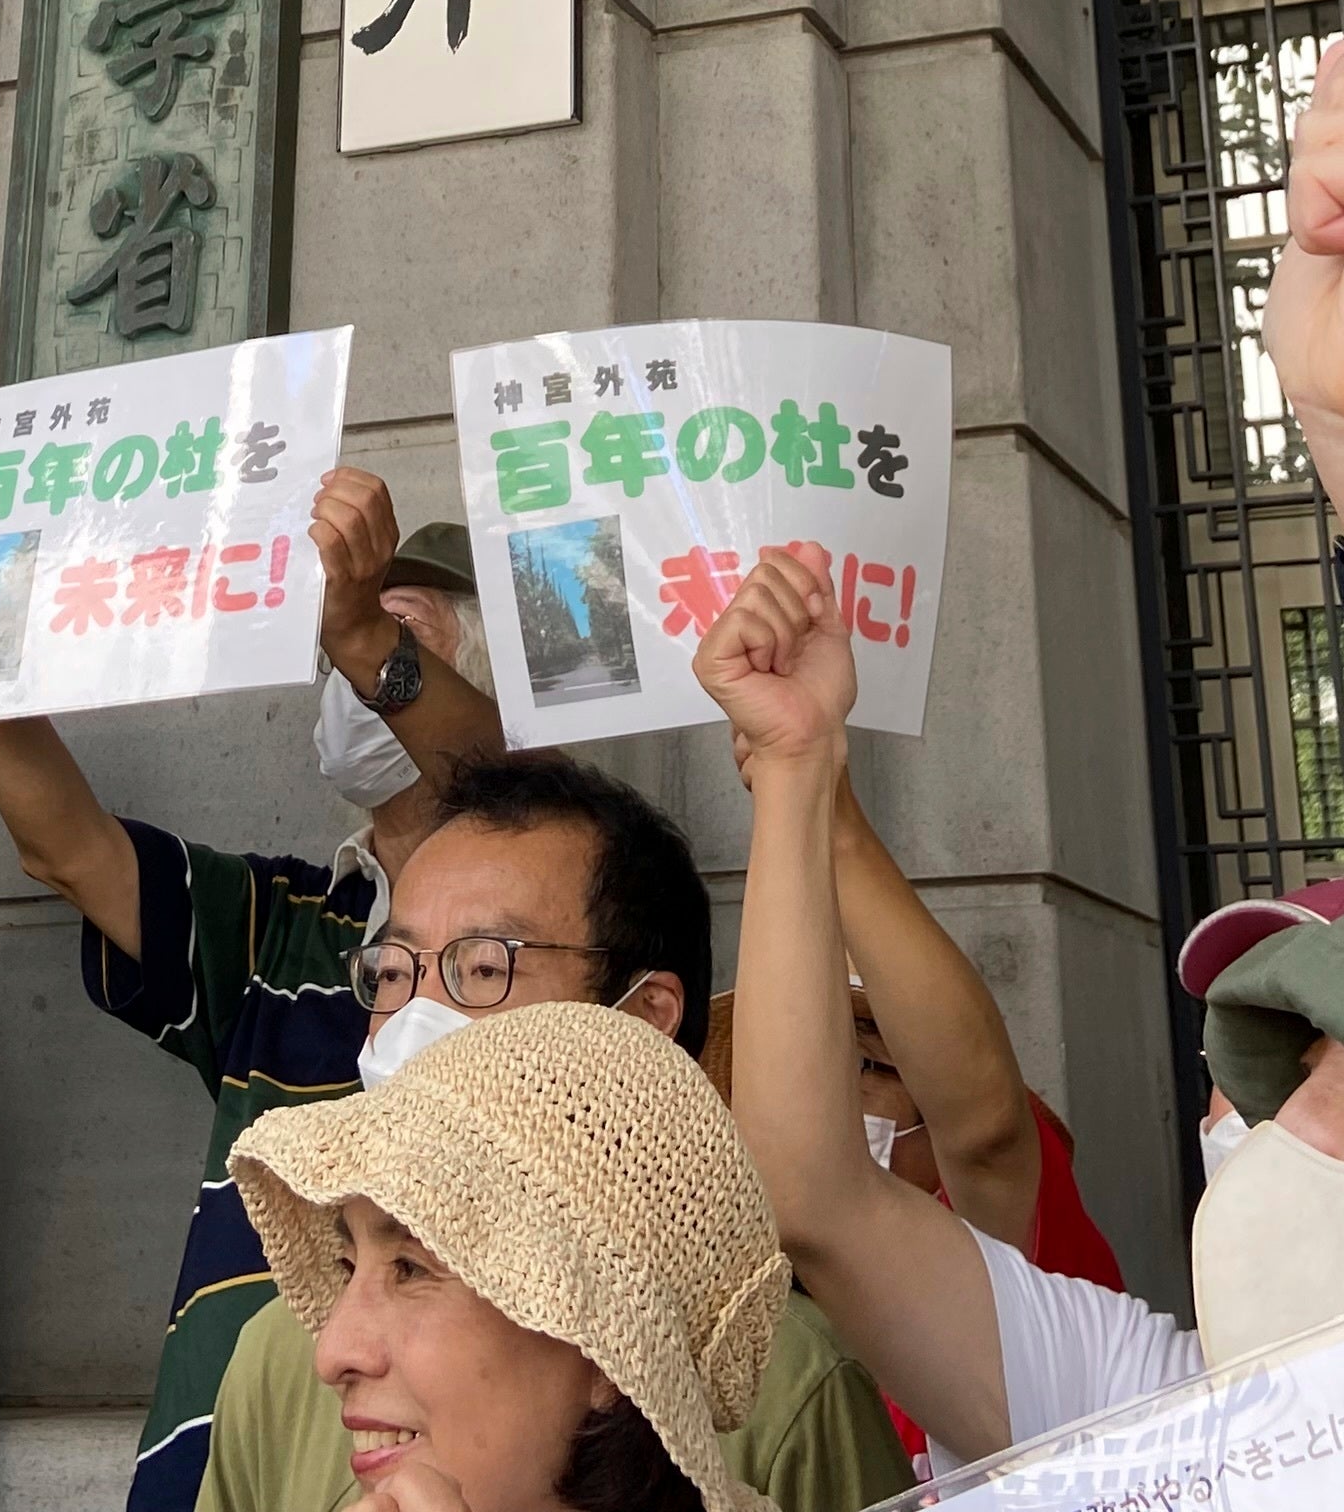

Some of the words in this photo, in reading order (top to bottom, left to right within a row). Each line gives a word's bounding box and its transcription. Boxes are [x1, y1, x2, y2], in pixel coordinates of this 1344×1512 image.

[494, 358, 678, 414] 神宮外苑
[490, 399, 909, 515] 百年の杜を
[49, 535, 291, 636] 未来に!
[659, 541, 916, 648] 未に!
